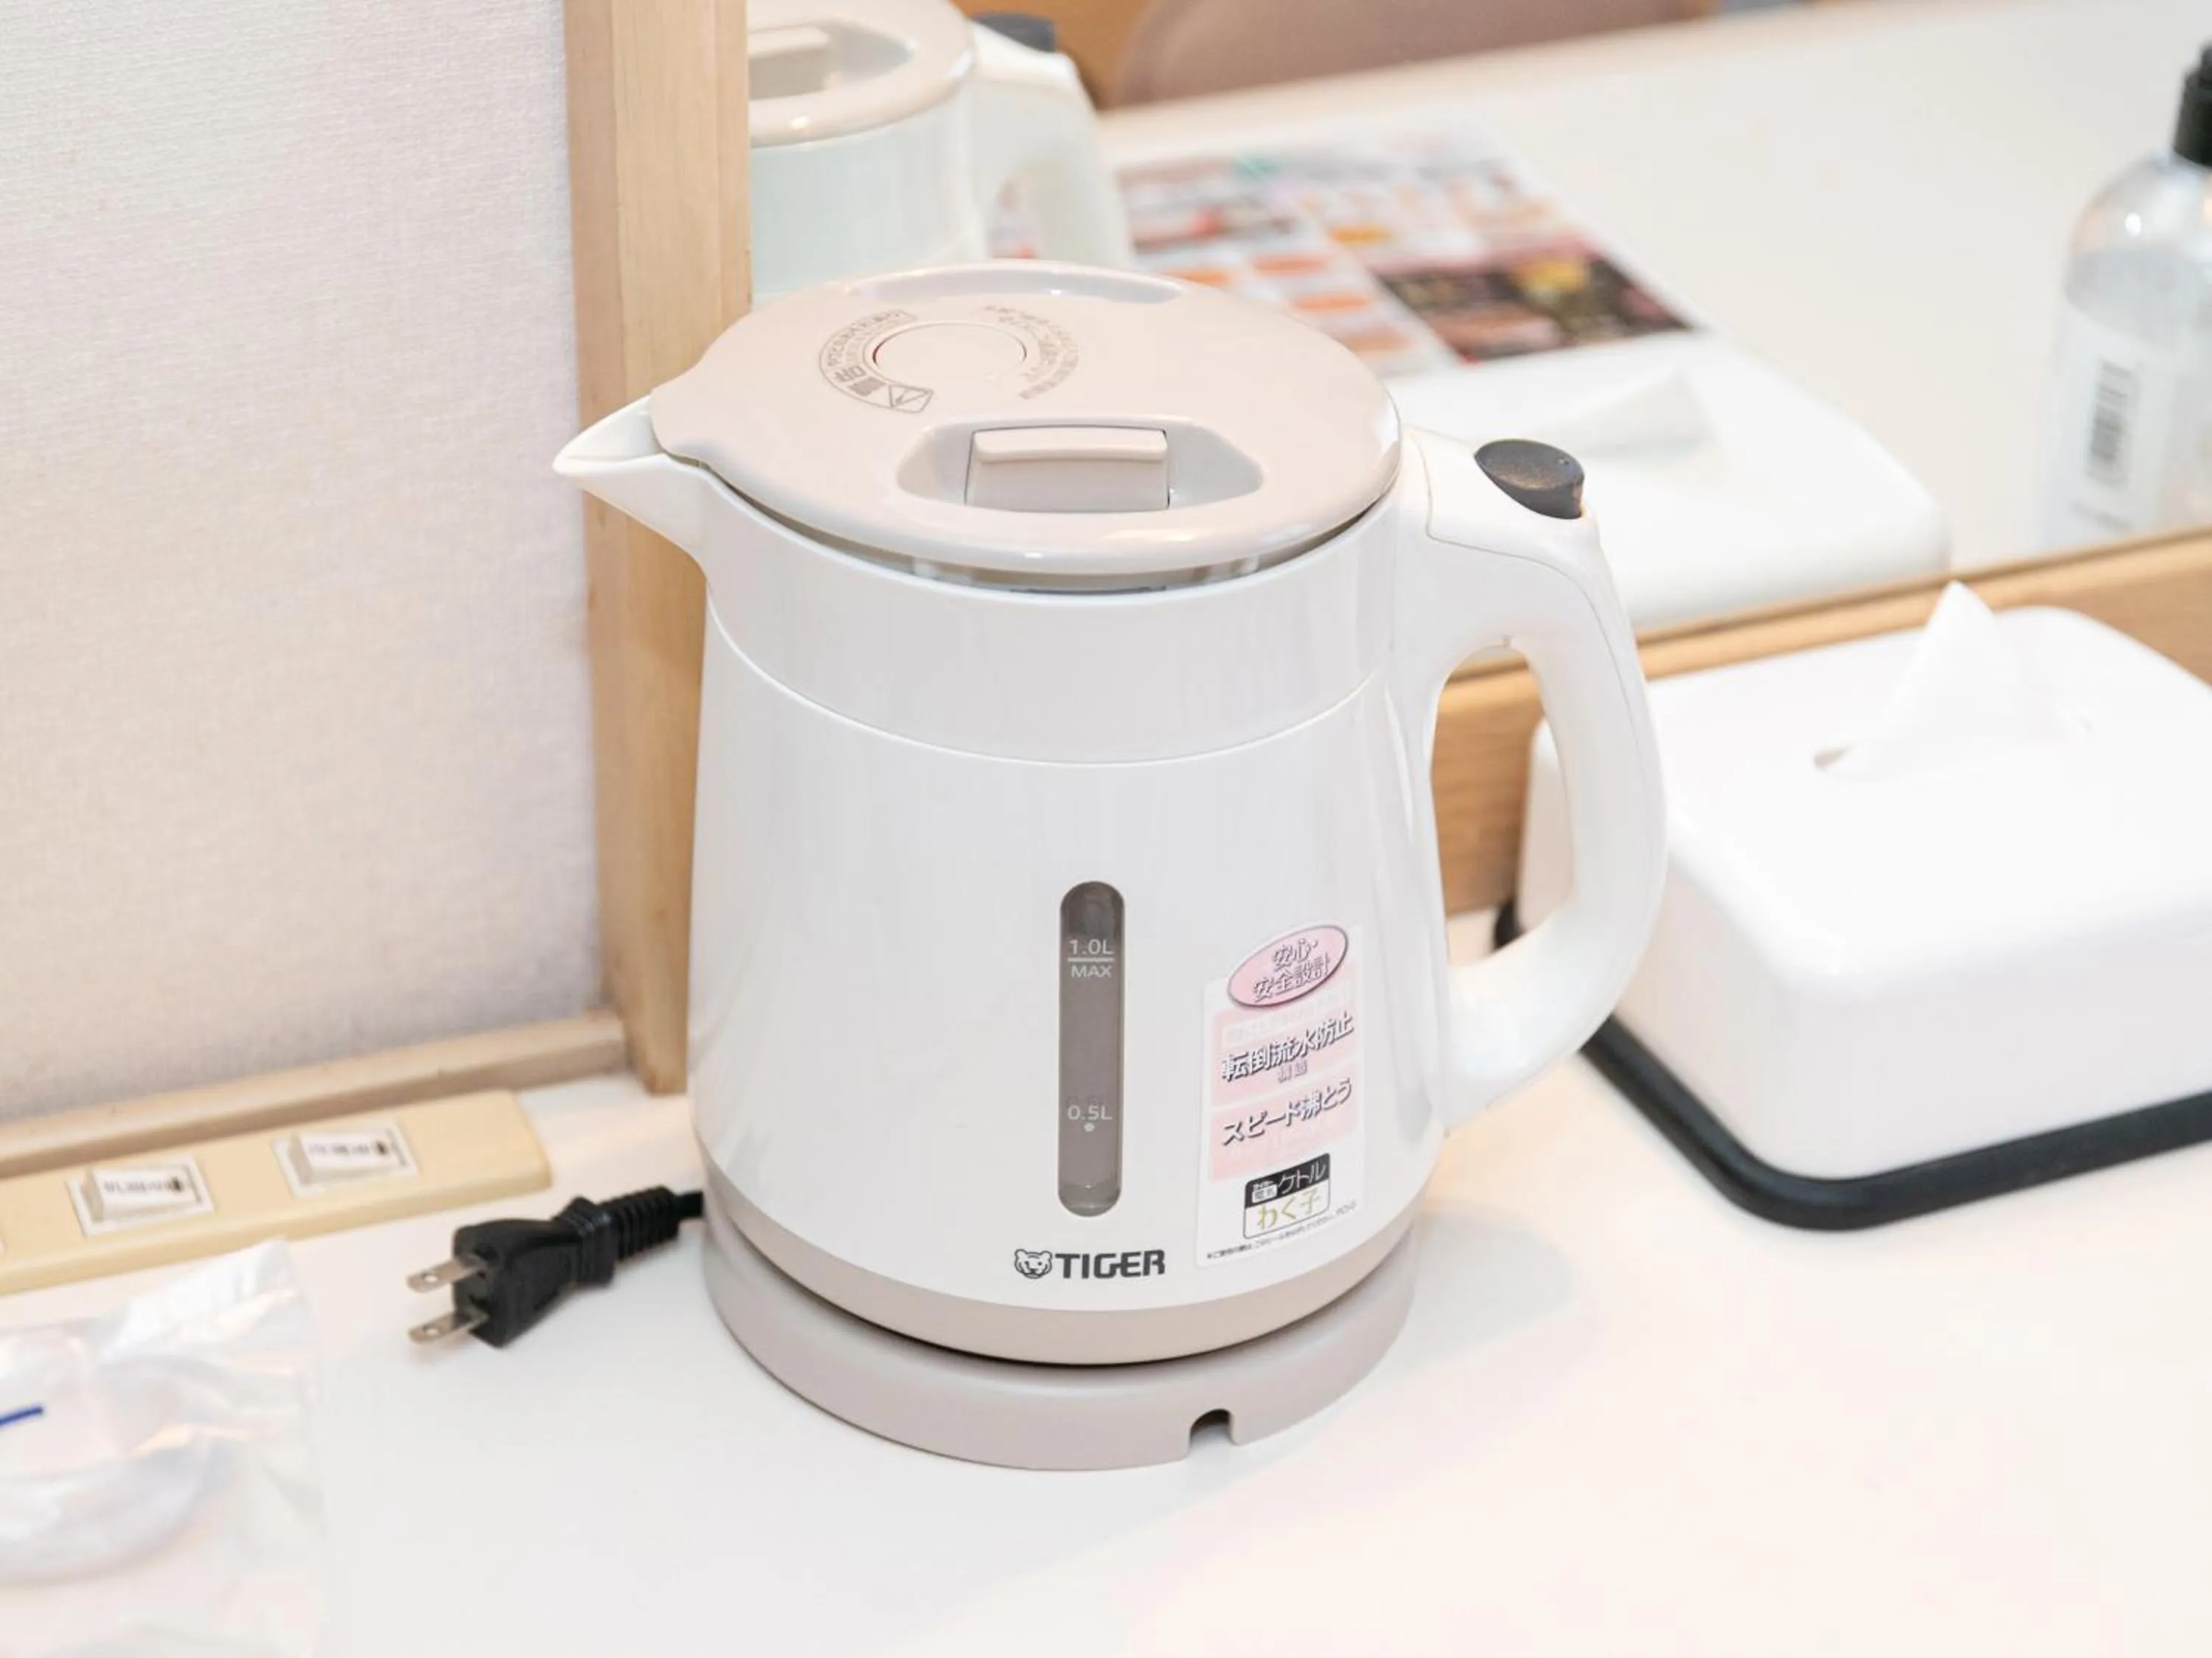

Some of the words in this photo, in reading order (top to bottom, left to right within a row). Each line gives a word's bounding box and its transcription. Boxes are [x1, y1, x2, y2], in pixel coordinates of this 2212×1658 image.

[1068, 938, 1115, 955] 1.0L
[1071, 964, 1112, 979] MAX
[1221, 1009, 1354, 1083] 転倒流水防止
[1067, 1104, 1114, 1121] 0.5L
[1054, 1249, 1166, 1280] TIGER
